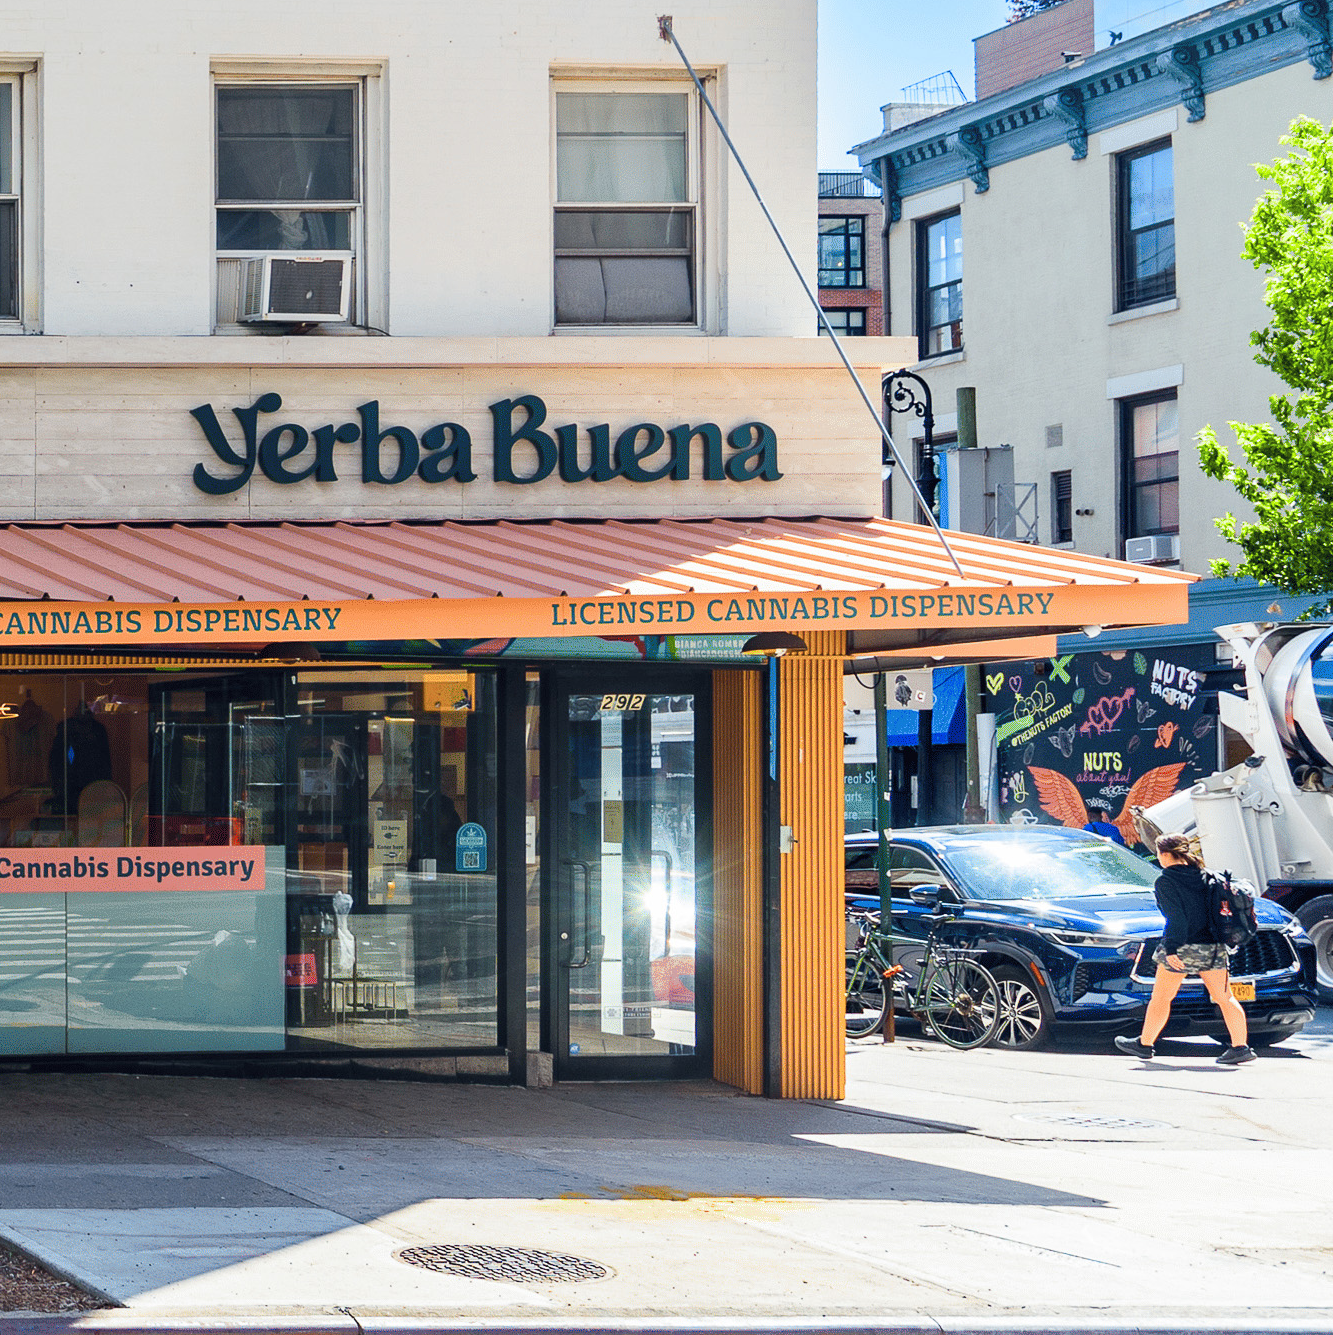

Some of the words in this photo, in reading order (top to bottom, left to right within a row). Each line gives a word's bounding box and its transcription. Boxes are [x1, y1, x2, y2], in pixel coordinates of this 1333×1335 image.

[189, 392, 478, 496] Yerba
[488, 394, 784, 485] Buena
[154, 608, 341, 633] DISPENSARY
[552, 600, 695, 626] LICENSED
[707, 596, 858, 622] CANNABIS
[870, 593, 1054, 618] DISPENSARY
[674, 639, 709, 649] BIANCA
[712, 639, 745, 649] ROMER
[1152, 659, 1198, 693] NUTS
[602, 696, 644, 710] 292
[1150, 681, 1197, 710] FACTORY
[1045, 703, 1073, 728] FACTORY
[1083, 751, 1123, 772] NUTS
[844, 773, 863, 784] reat
[117, 855, 255, 883] Dispensary
